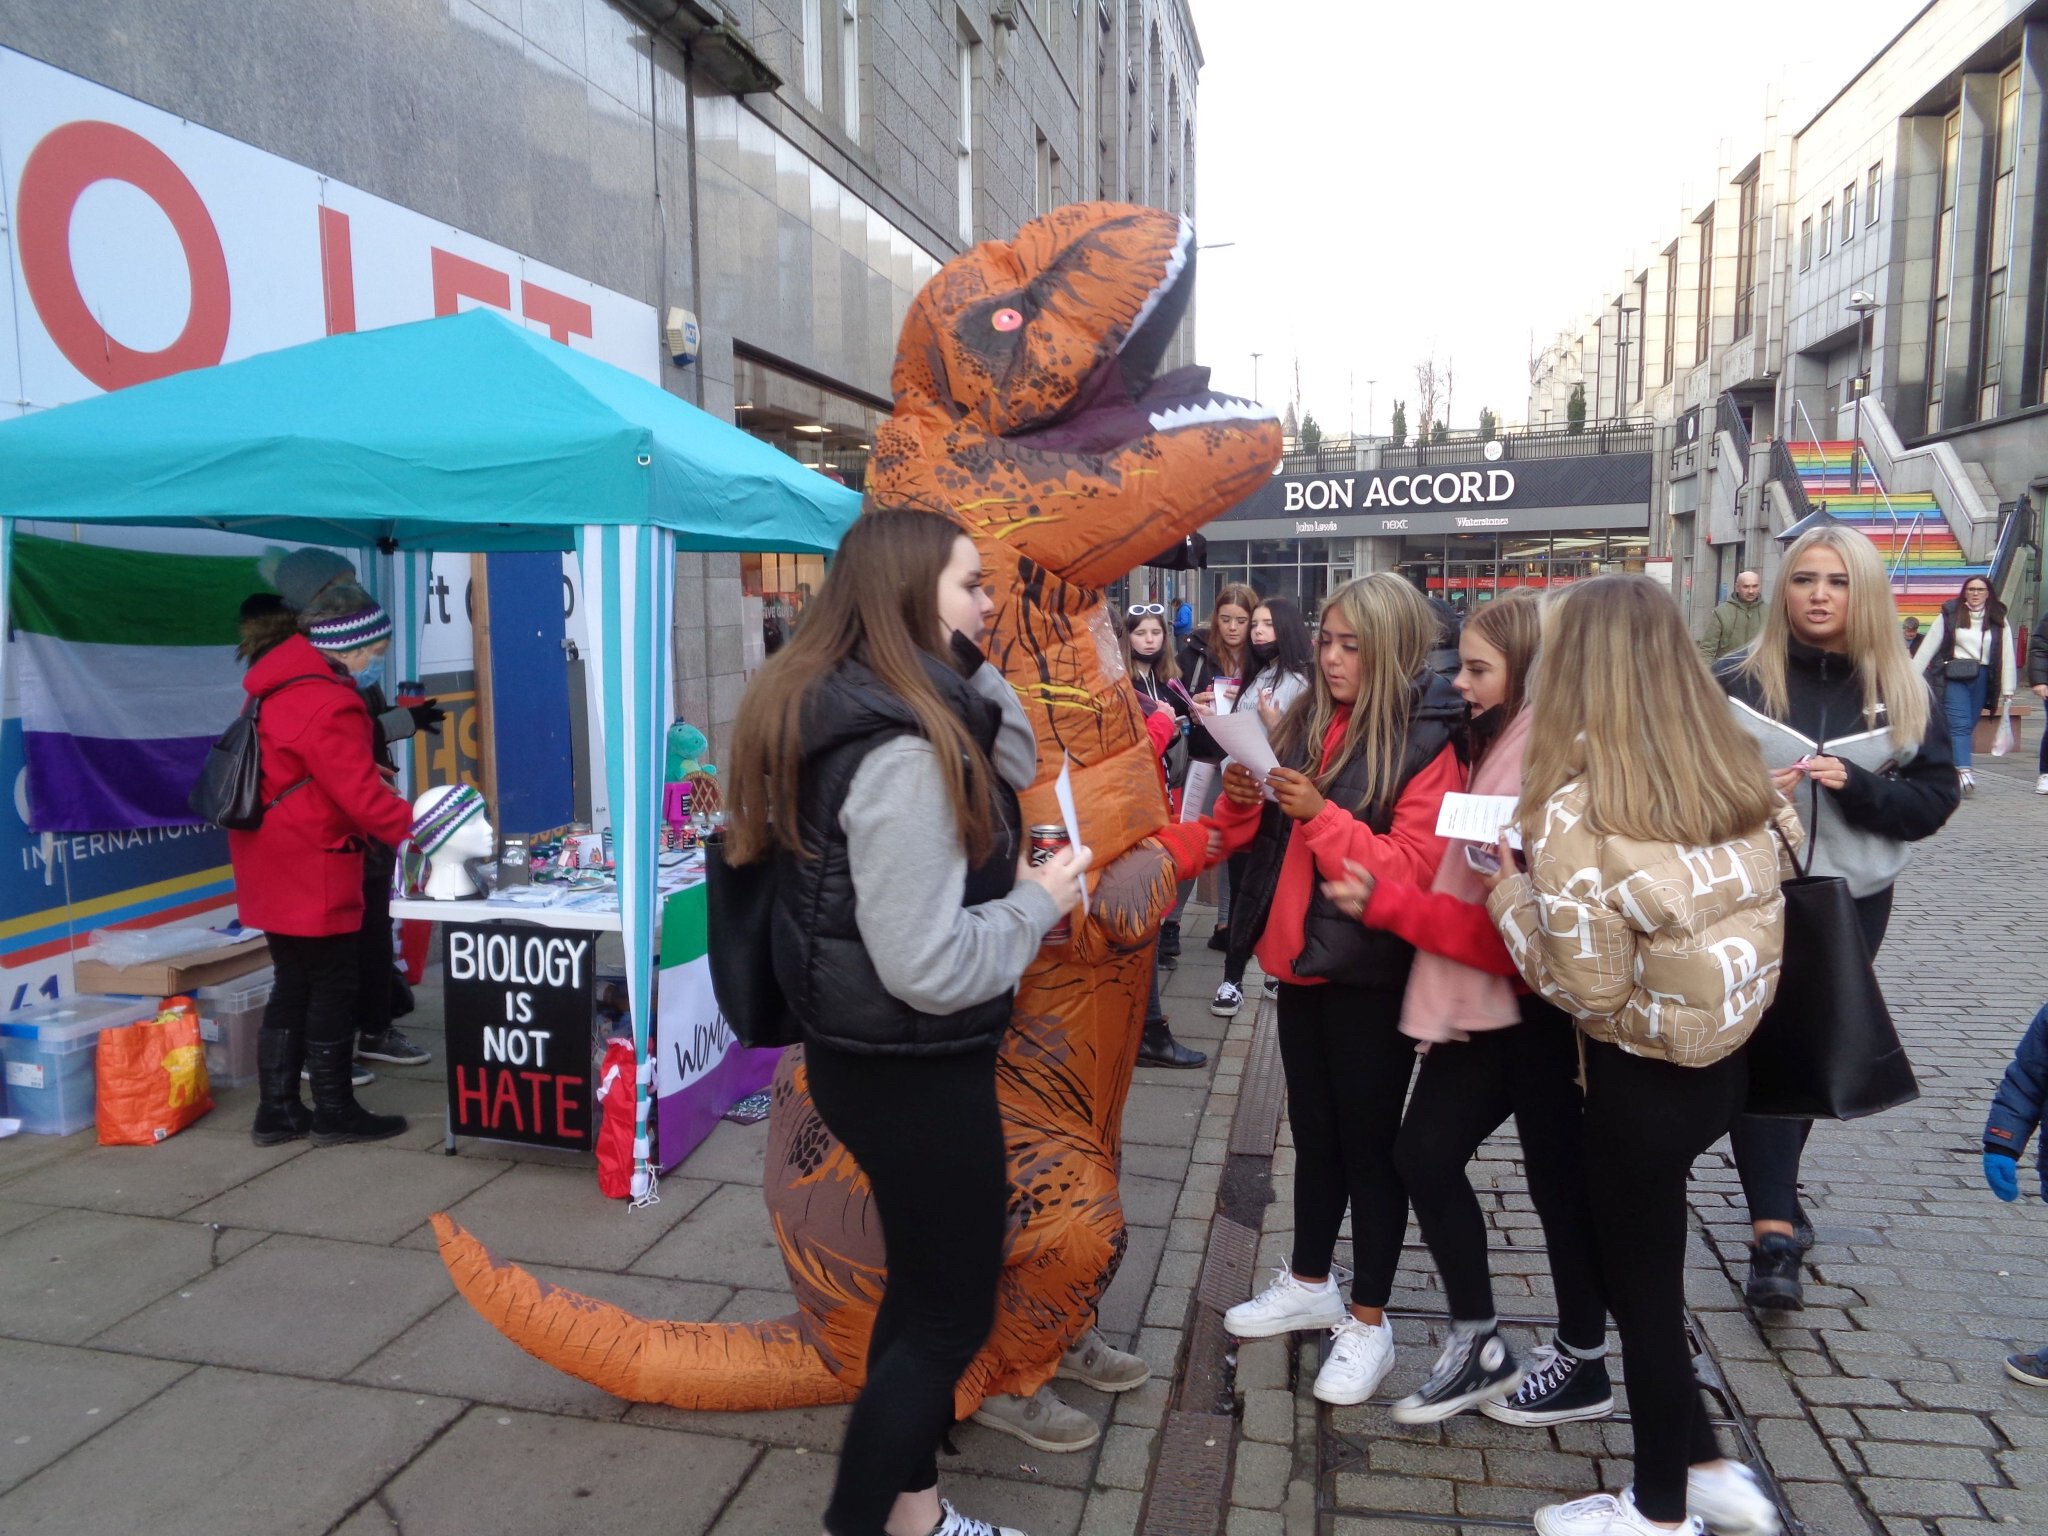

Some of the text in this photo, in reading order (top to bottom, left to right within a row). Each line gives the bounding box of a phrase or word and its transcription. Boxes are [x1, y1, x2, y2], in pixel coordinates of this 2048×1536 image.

[1285, 469, 1516, 511] BON ACCORD
[1295, 521, 1338, 534] John Lewis
[1381, 519, 1409, 530] next
[1455, 516, 1509, 527] Waterstones
[449, 930, 588, 990] BIOLOGY
[505, 991, 533, 1023] IS
[483, 1025, 551, 1068] NOT
[456, 1064, 584, 1138] HATE
